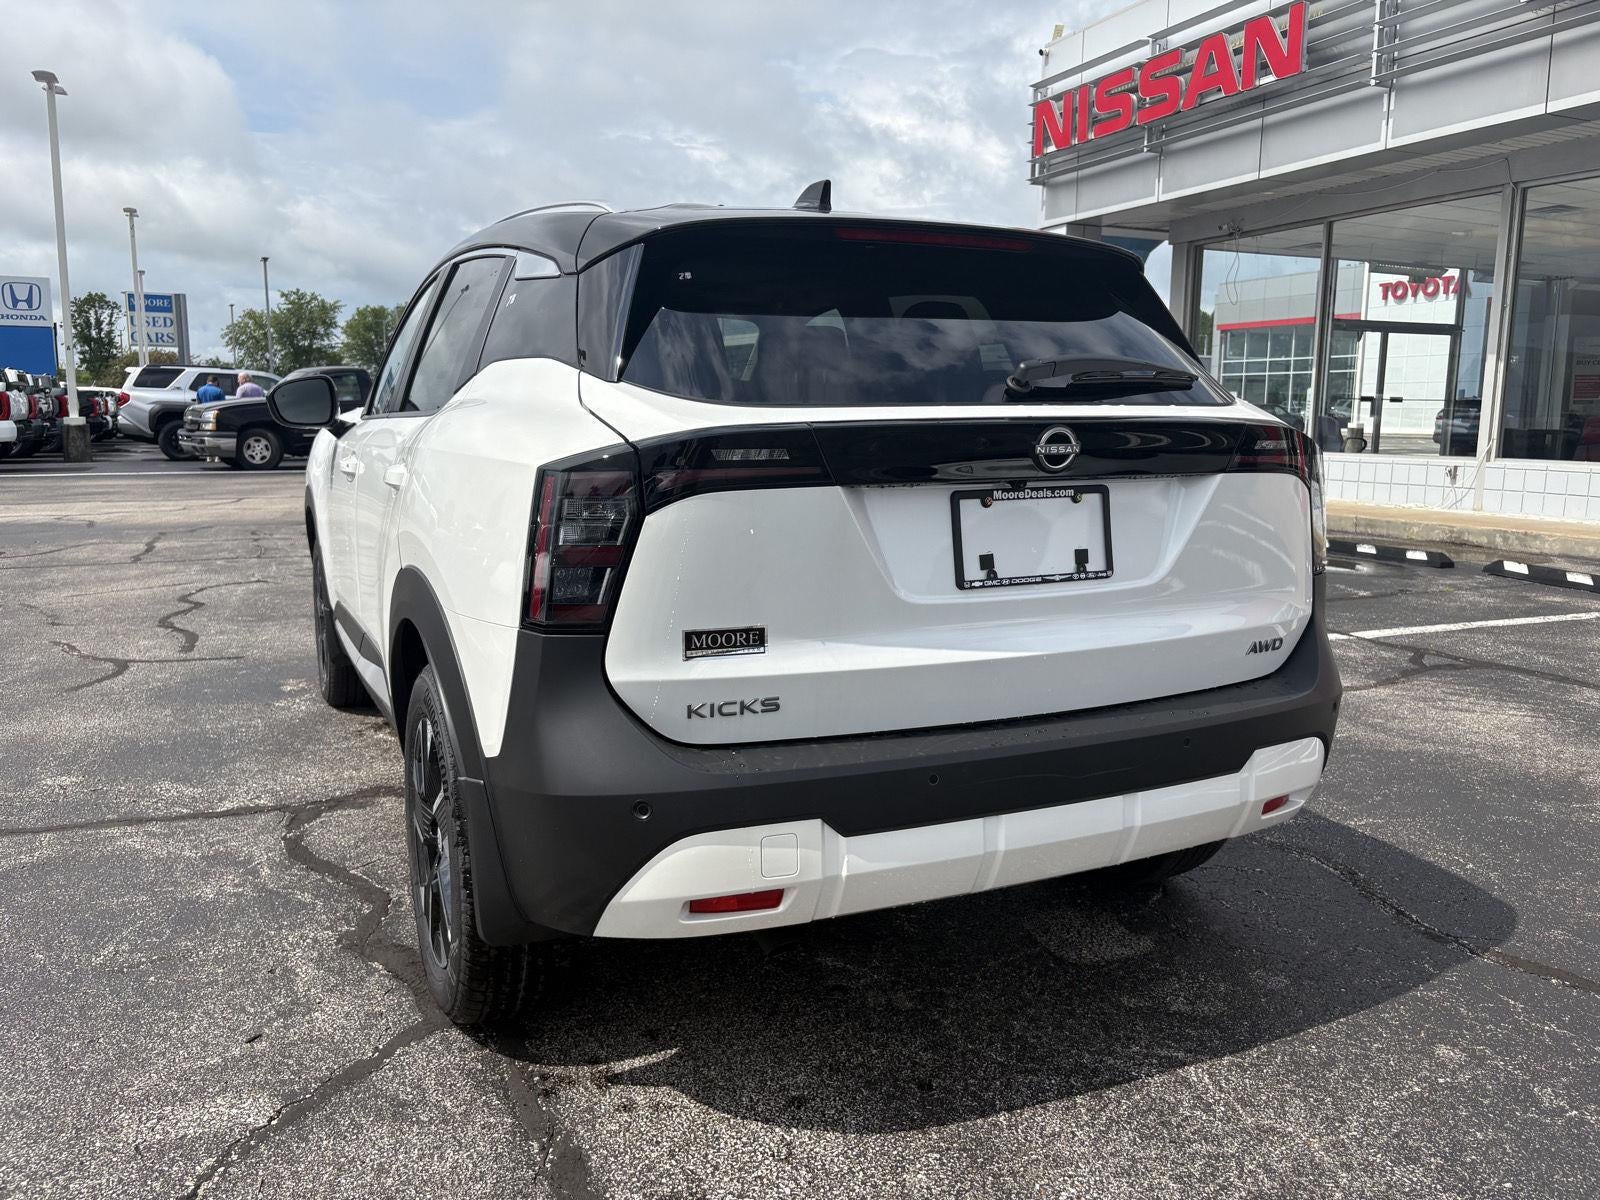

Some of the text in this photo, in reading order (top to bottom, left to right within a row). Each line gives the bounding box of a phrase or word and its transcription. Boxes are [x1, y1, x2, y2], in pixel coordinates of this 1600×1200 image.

[1035, 3, 1305, 157] NISSAN
[1379, 276, 1471, 301] TOYOTA
[1036, 446, 1080, 454] NISSAN
[993, 488, 1074, 500] MooreDeals.com
[690, 631, 761, 649] MOORE
[1245, 638, 1283, 655] AWD
[687, 696, 780, 719] KICKS
